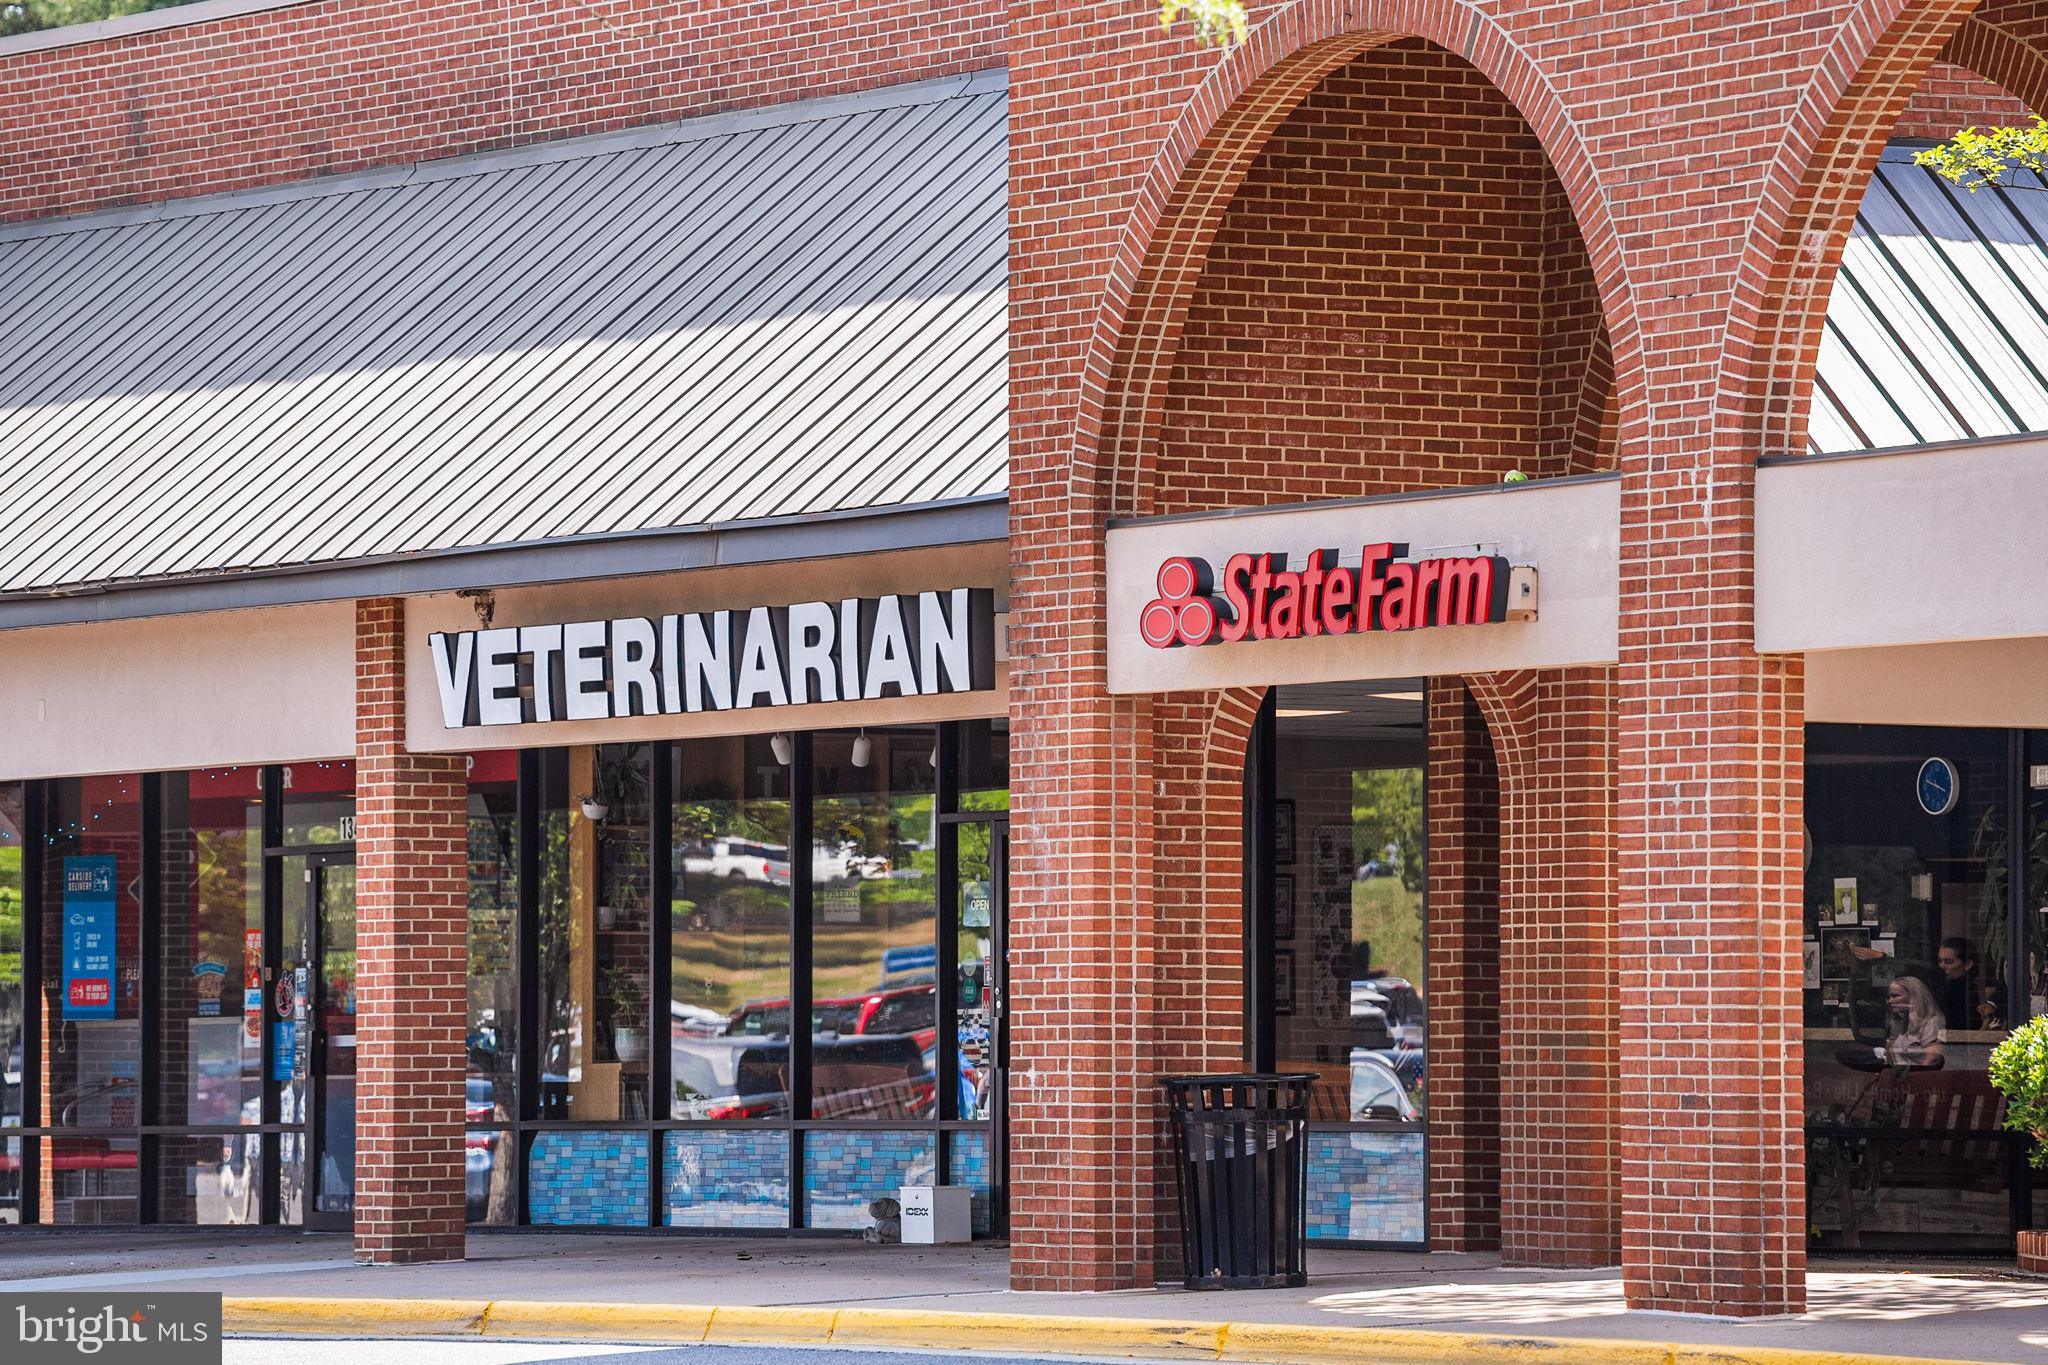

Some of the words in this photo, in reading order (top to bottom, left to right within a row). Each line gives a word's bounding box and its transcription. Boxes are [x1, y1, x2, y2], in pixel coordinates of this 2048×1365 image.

[429, 587, 974, 729] VETERINARIAN
[342, 816, 356, 840] 13
[68, 871, 92, 881] CARSIDE
[68, 882, 92, 891] DELIVERY
[825, 890, 859, 899] FRIEND
[970, 899, 990, 911] OPEN
[906, 1207, 929, 1216] IDEXX
